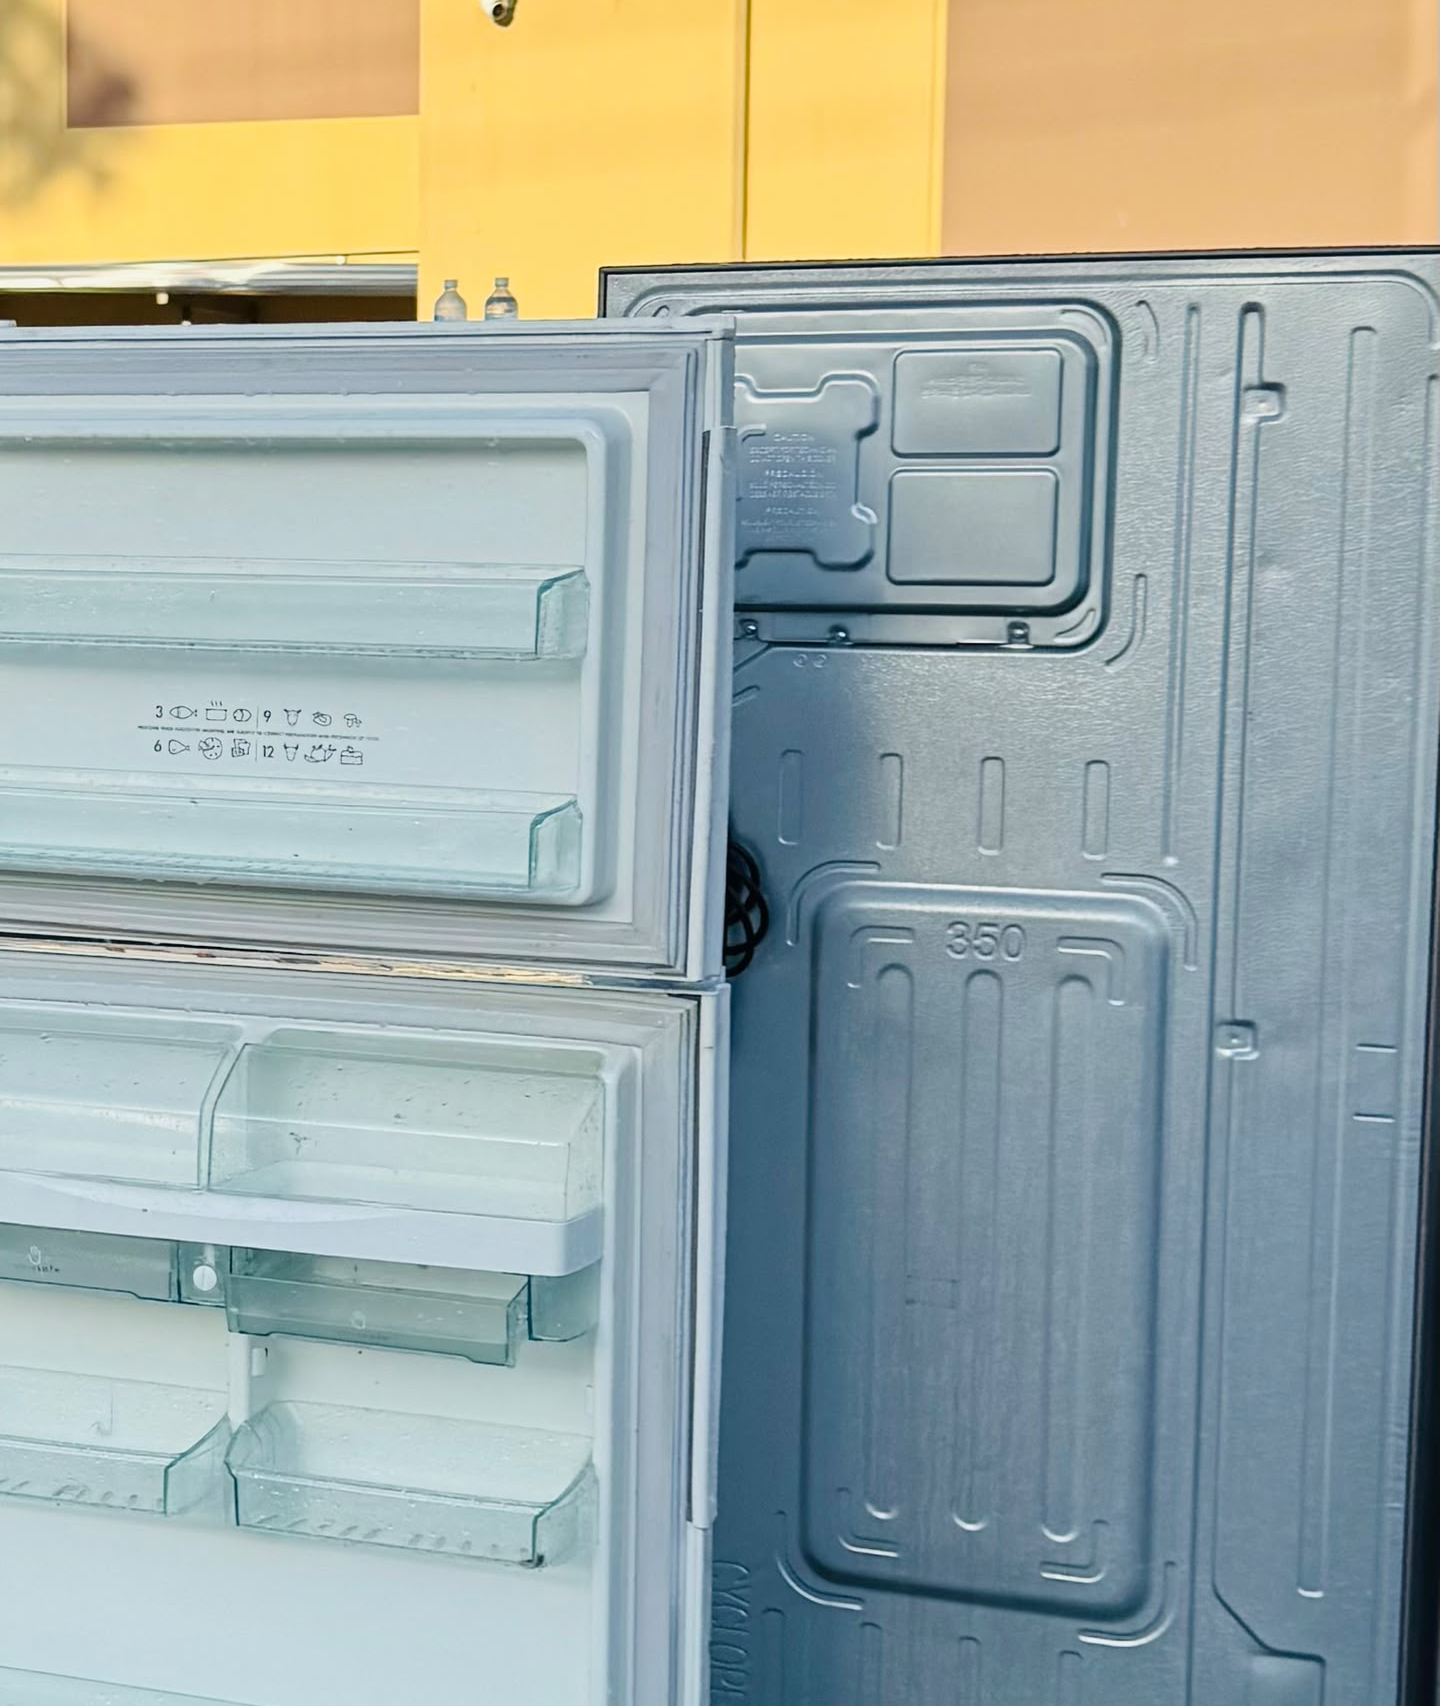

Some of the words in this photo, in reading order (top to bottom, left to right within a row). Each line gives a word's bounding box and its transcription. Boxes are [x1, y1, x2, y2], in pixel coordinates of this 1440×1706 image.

[155, 705, 164, 718] 3
[263, 710, 272, 723] 9
[153, 739, 162, 752] 6
[262, 745, 274, 758] 12
[945, 920, 1028, 962] 350
